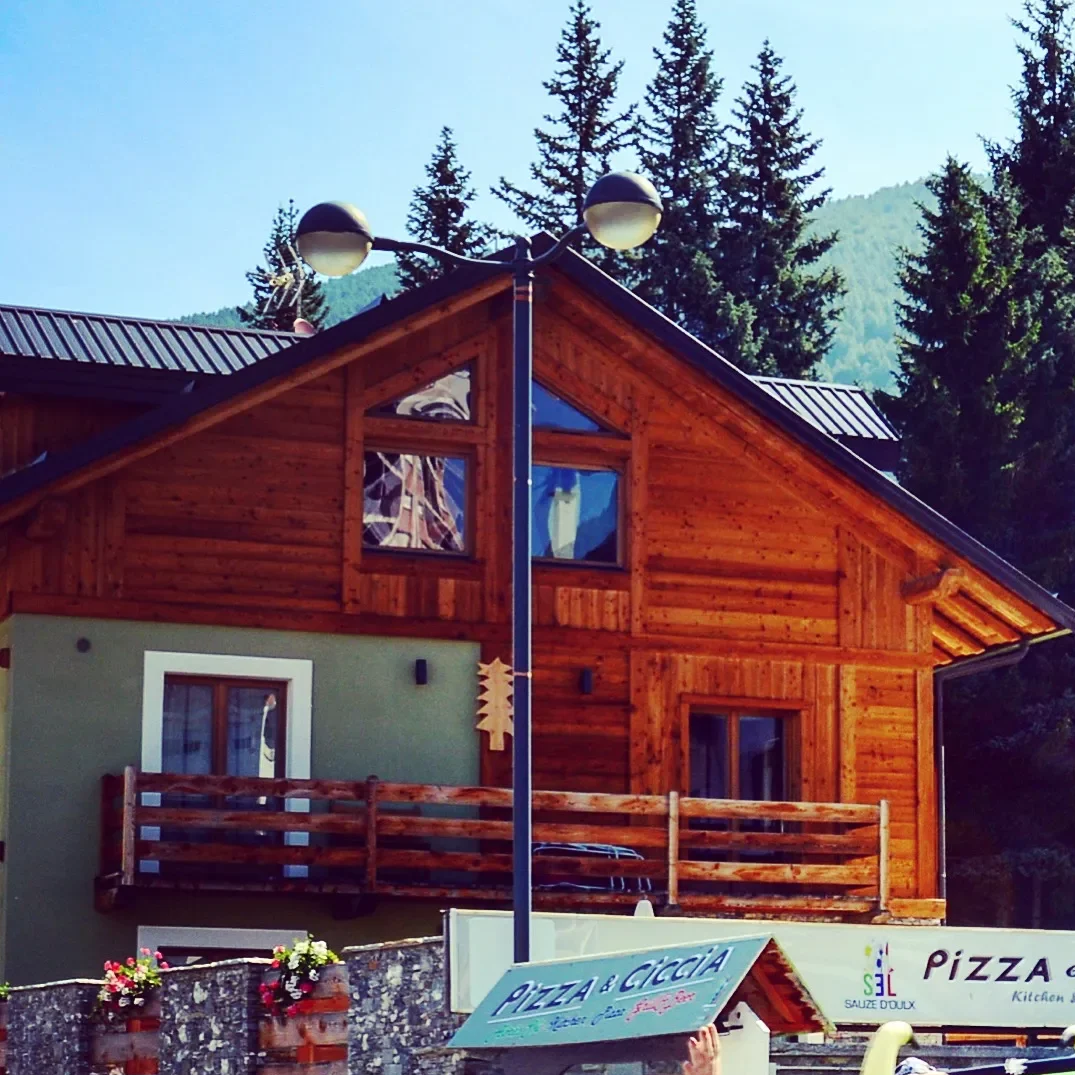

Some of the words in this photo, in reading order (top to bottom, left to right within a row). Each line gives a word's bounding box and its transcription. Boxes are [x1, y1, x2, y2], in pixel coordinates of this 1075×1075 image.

[600, 975, 619, 995] &
[1012, 990, 1064, 1003] Kitchen
[844, 999, 878, 1010] SAUZE
